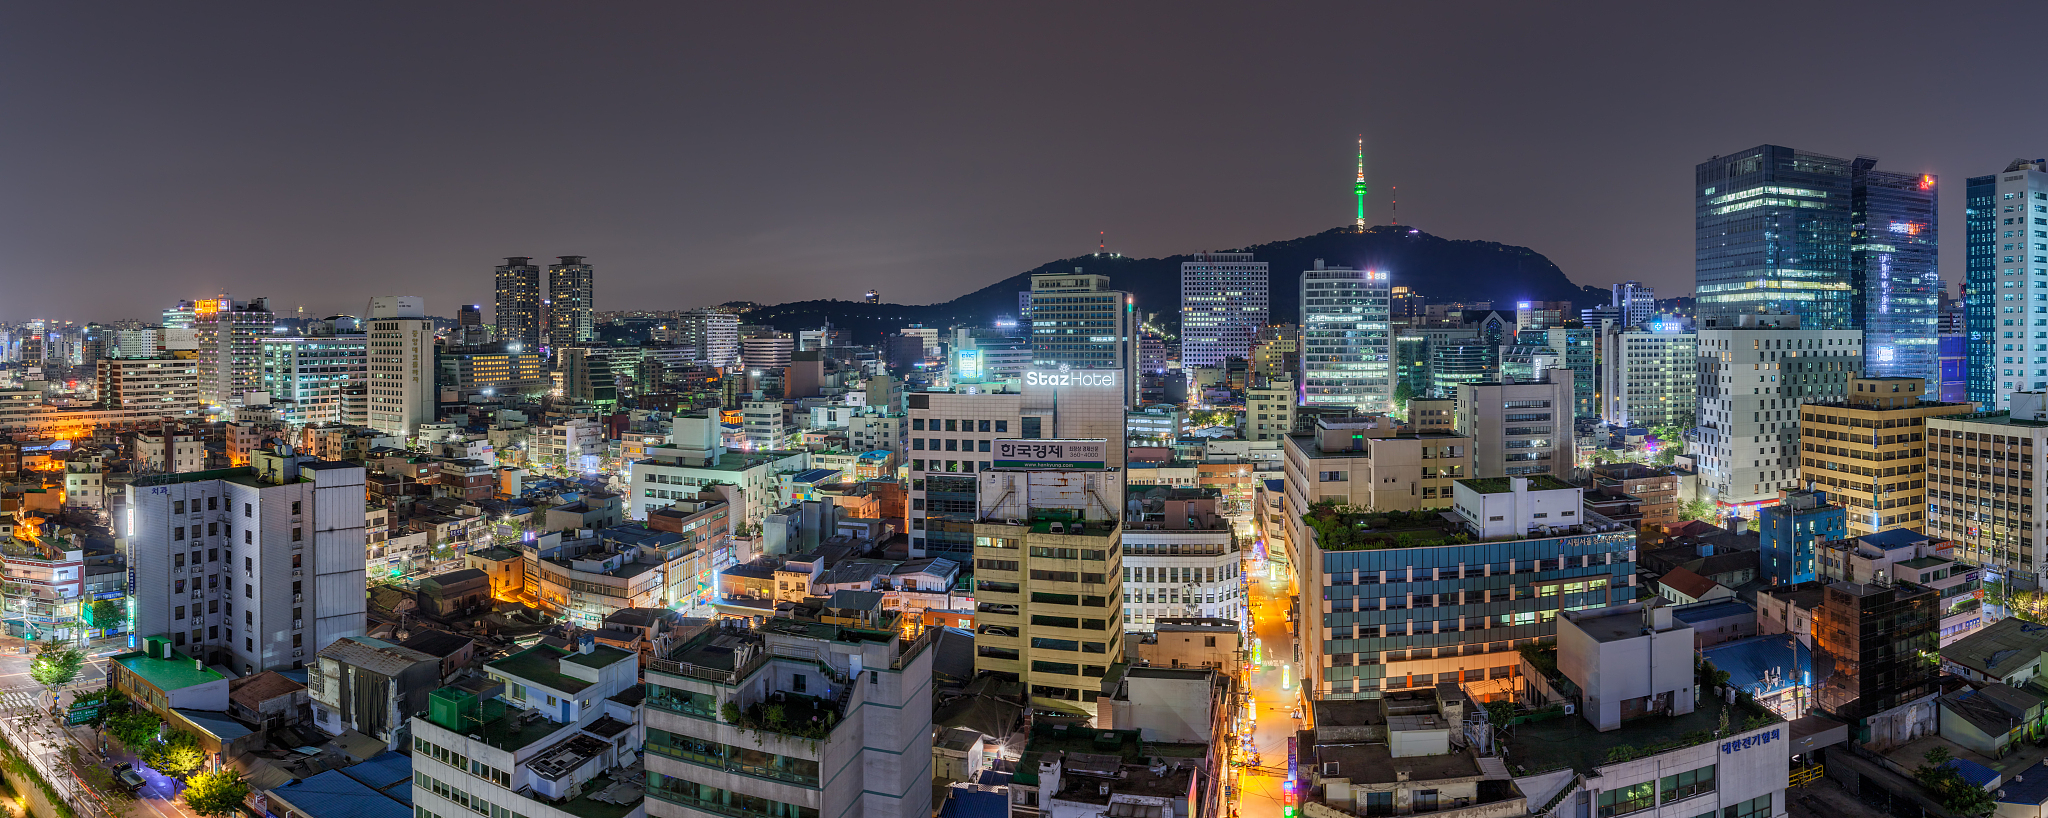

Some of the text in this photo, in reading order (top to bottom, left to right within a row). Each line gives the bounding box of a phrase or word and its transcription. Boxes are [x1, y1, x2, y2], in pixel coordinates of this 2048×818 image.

[1001, 444, 1063, 459] 한국경제
[152, 487, 168, 496] 치과
[1722, 728, 1780, 754] 대한전기협회
